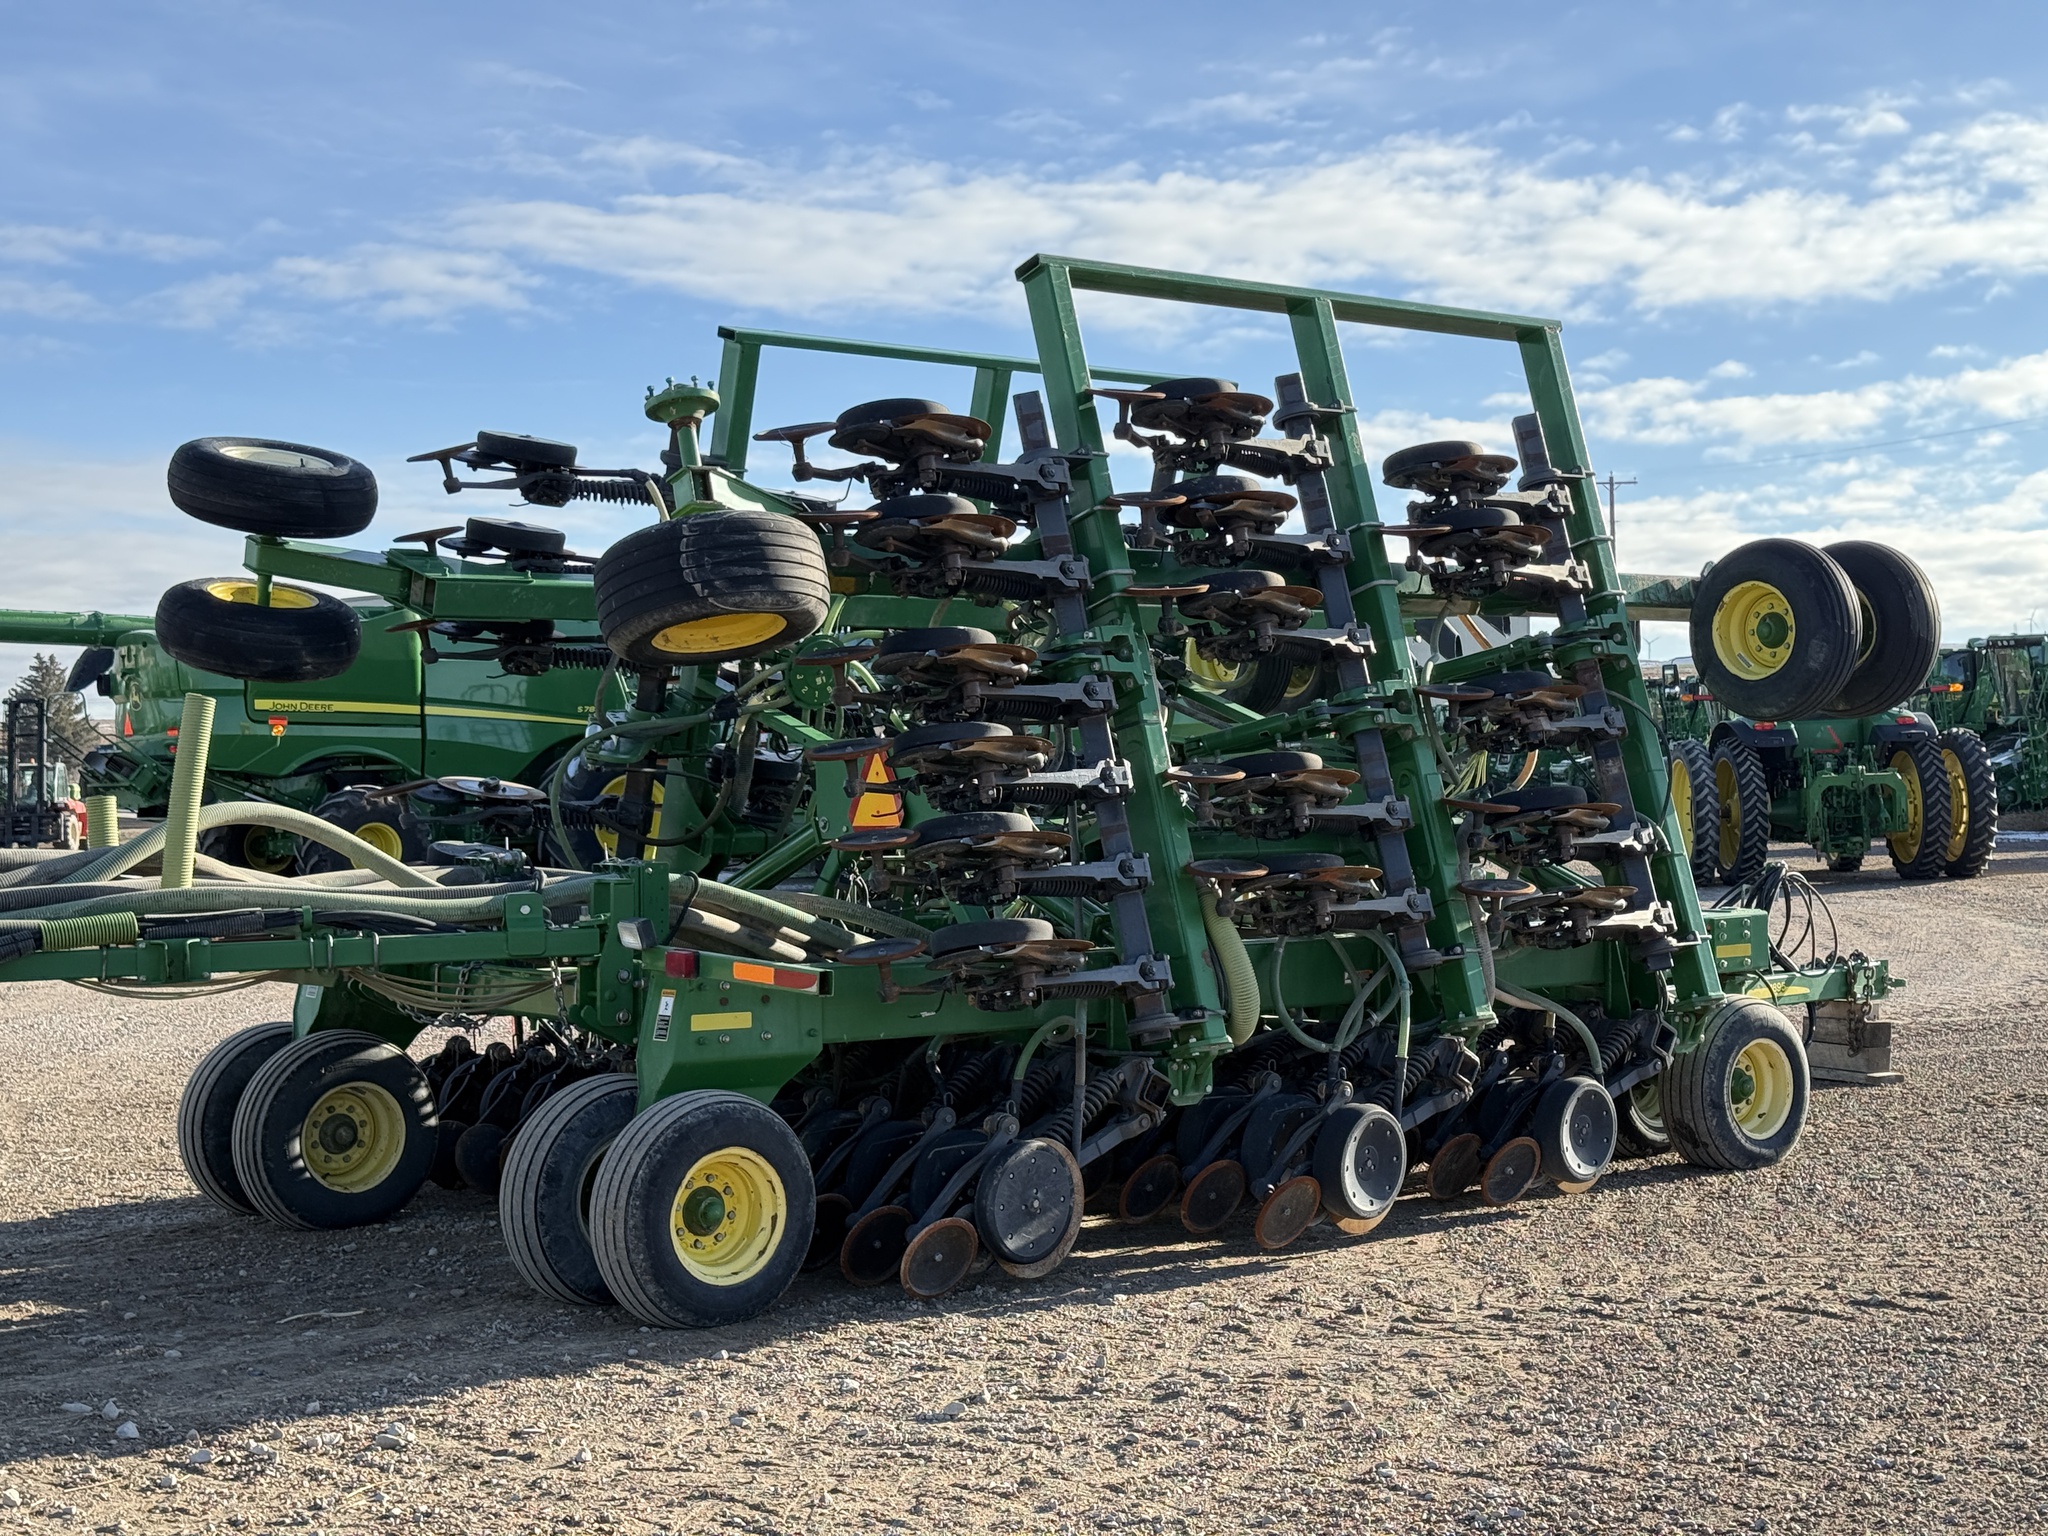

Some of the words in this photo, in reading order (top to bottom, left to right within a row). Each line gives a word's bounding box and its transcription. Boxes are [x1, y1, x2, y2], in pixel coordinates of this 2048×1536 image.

[269, 701, 298, 710] JOHN
[300, 701, 334, 711] DEERE
[577, 705, 596, 713] S78
